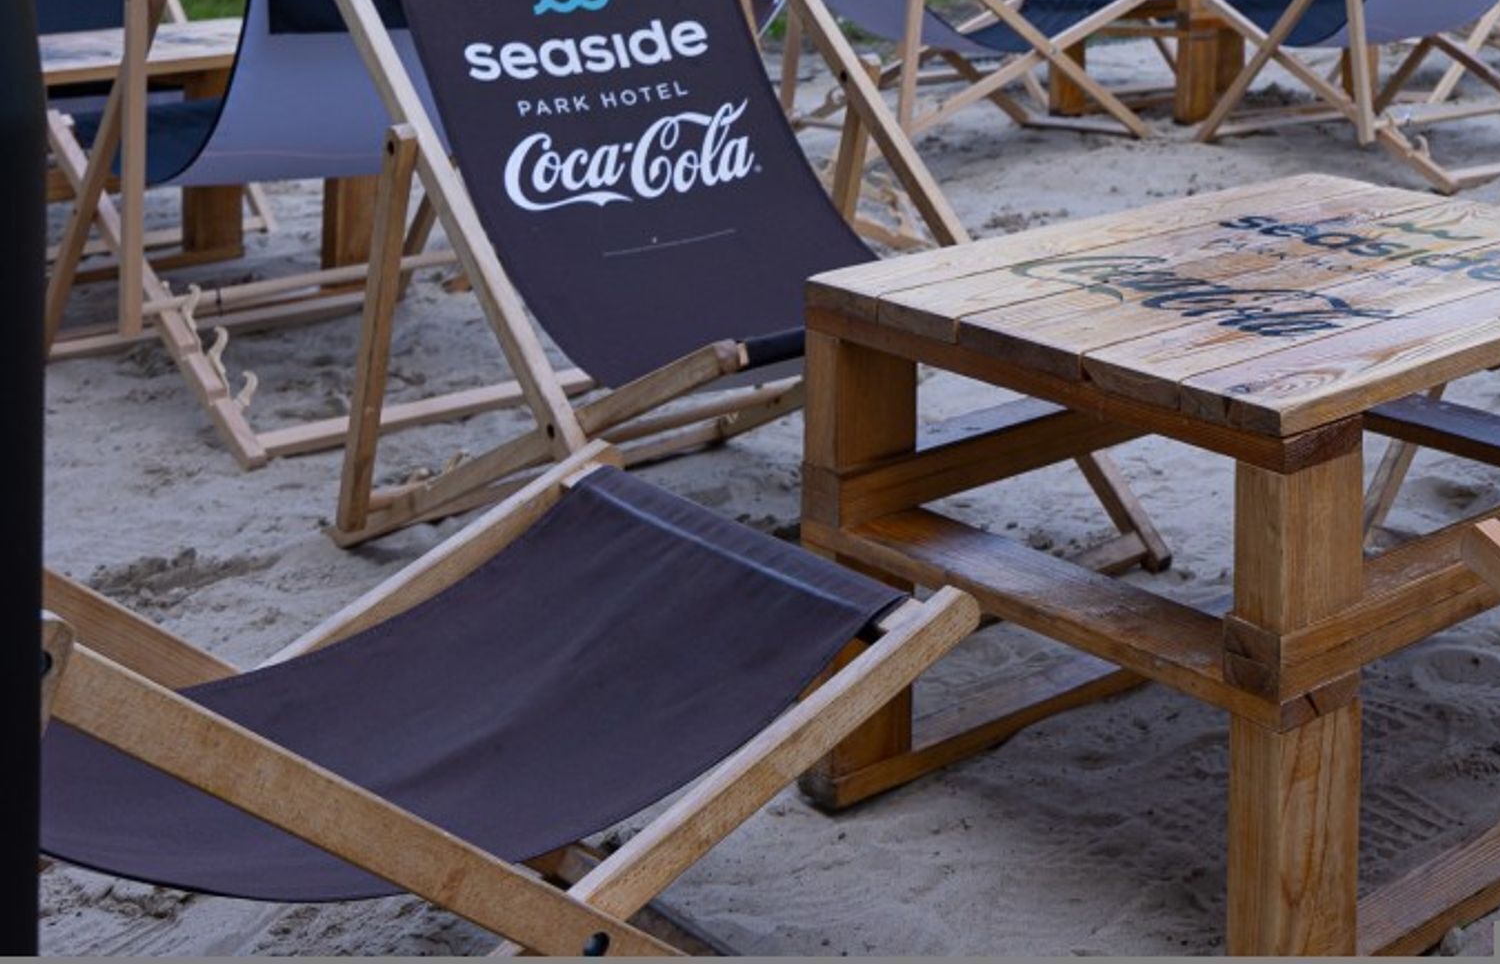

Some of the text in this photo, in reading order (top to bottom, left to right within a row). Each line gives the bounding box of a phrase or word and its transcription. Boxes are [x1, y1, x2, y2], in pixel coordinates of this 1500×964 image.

[464, 19, 708, 81] seaside
[517, 81, 689, 117] PARK HOTEL
[504, 99, 755, 211] Coca-Cola
